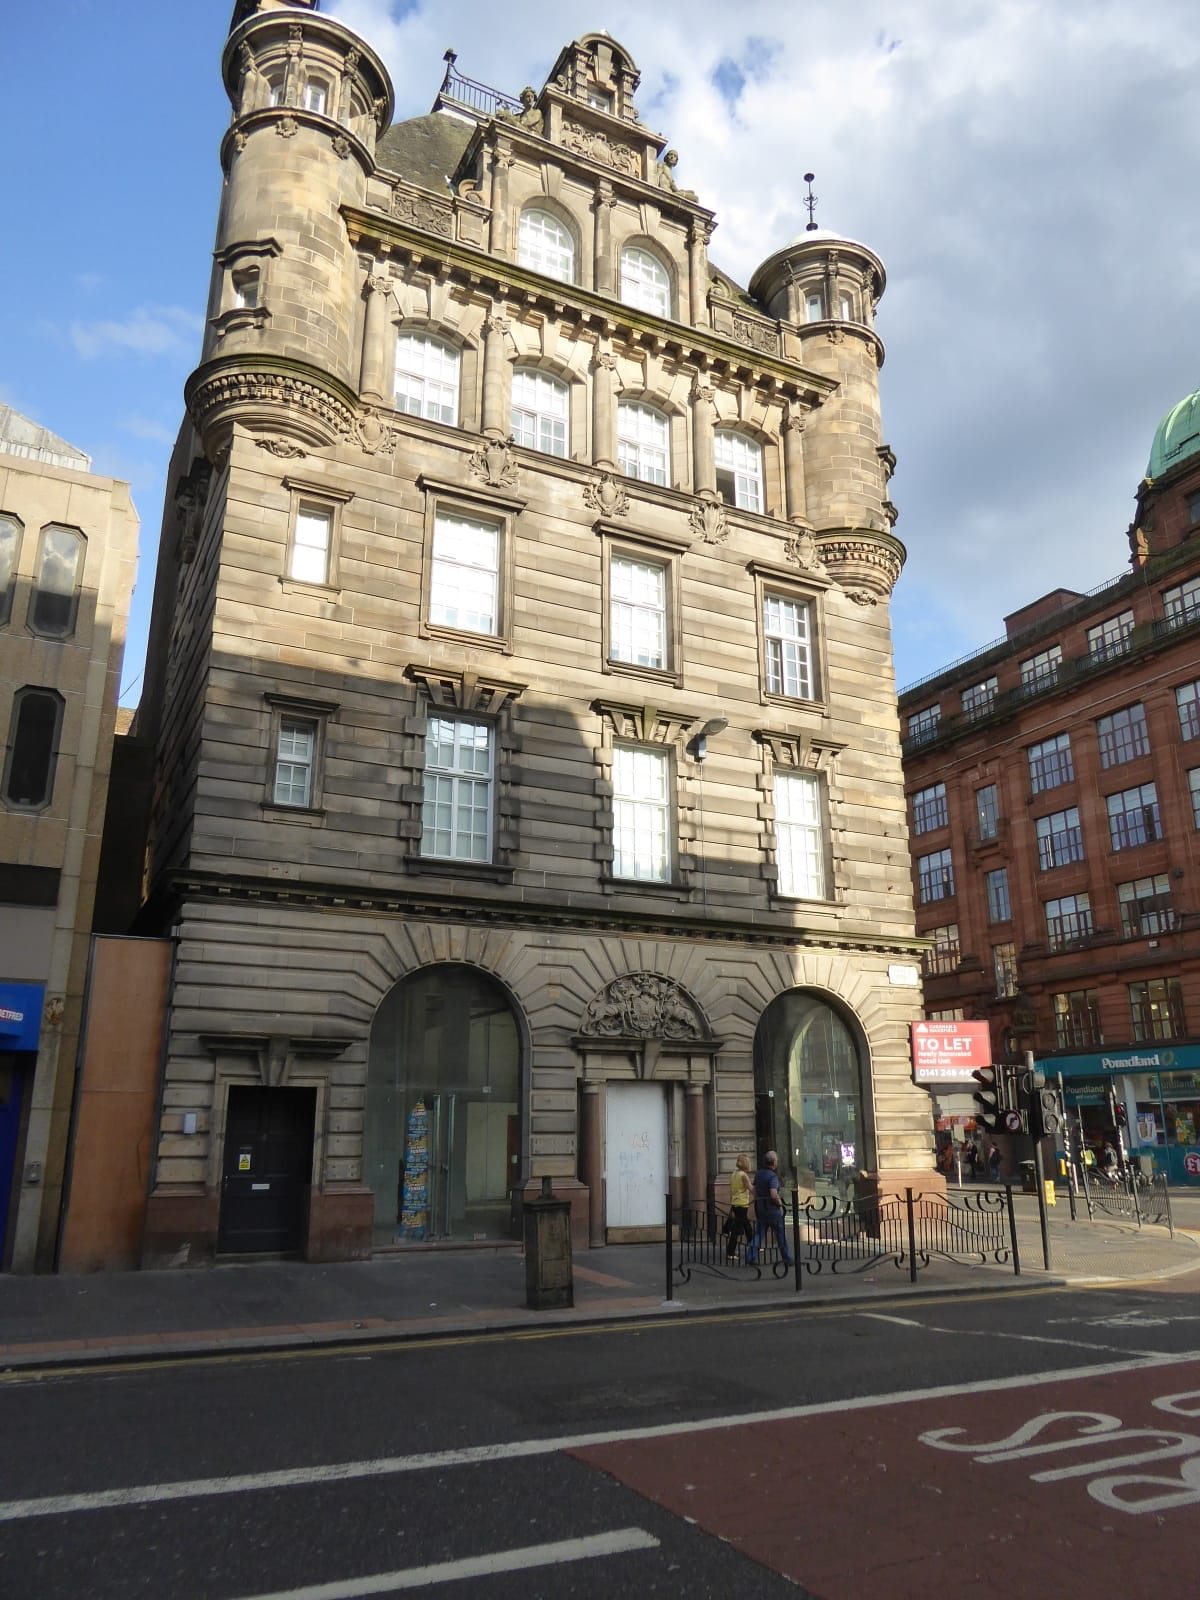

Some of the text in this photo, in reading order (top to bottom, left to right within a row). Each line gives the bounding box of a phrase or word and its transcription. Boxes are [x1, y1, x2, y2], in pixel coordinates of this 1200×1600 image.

[917, 1037, 972, 1051] TO LET
[1101, 1054, 1160, 1069] Poundland
[919, 1068, 939, 1077] 0141
[1065, 1083, 1104, 1094] Poundland
